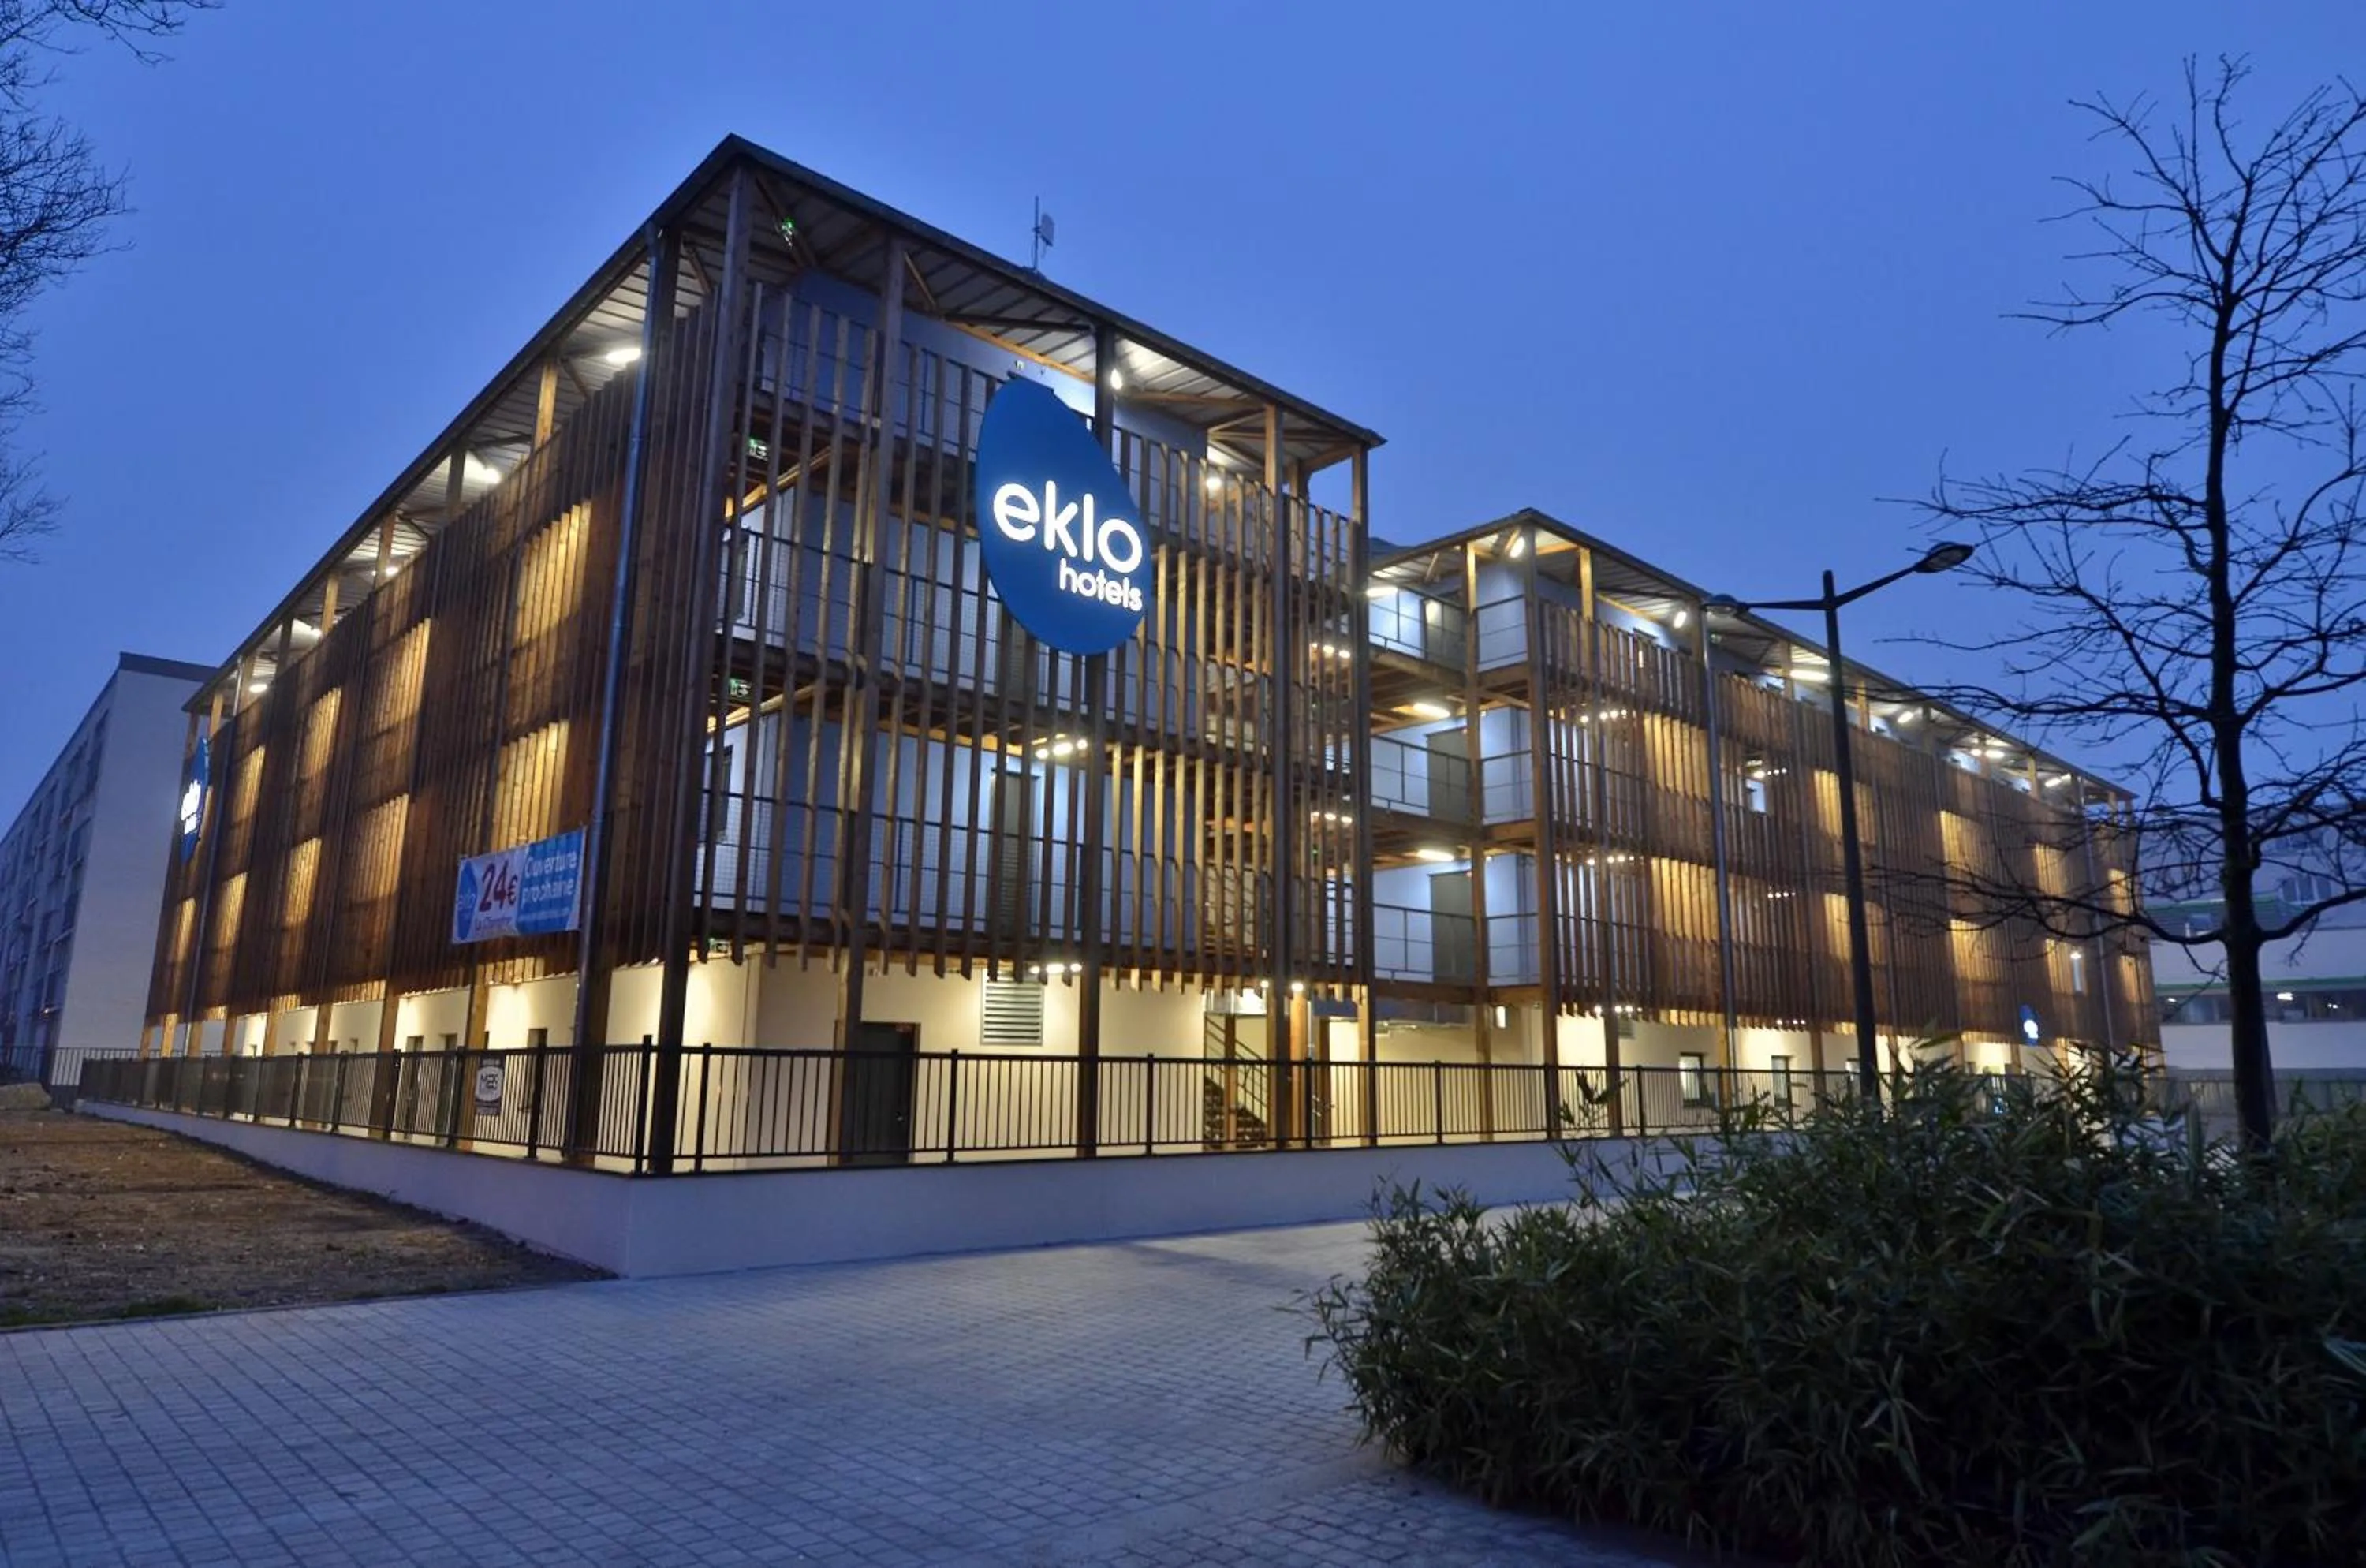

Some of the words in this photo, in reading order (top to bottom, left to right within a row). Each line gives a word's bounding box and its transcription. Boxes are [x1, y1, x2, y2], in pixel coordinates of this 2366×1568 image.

[993, 480, 1144, 574] eklo
[1059, 557, 1143, 612] hotels
[478, 859, 517, 912] 24€
